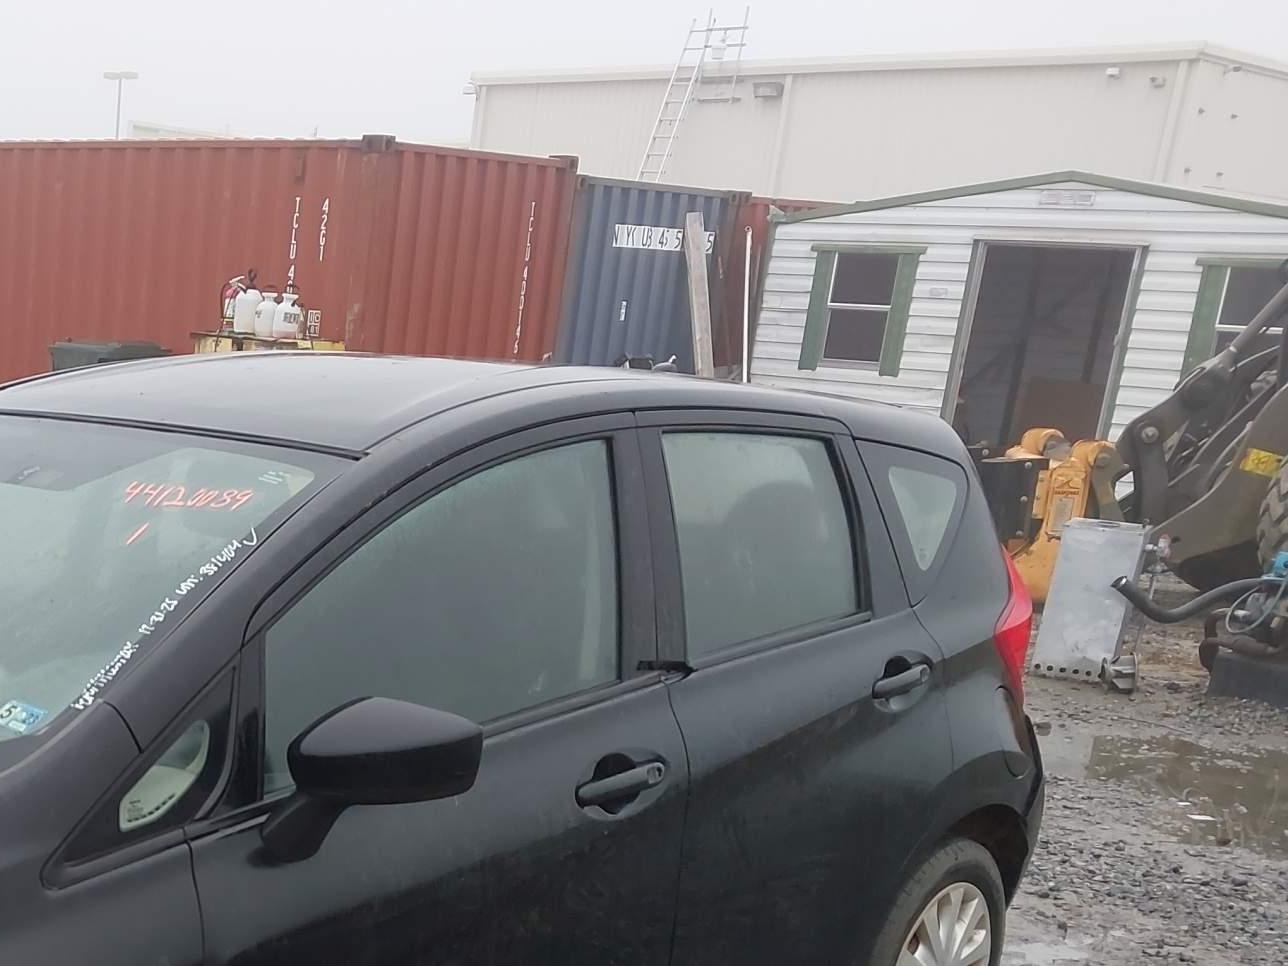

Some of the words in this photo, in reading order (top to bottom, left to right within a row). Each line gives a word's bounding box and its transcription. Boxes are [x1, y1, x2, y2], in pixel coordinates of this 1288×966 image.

[289, 197, 301, 260] TCLU
[319, 198, 330, 262] 42G1
[124, 479, 254, 512] 44120089
